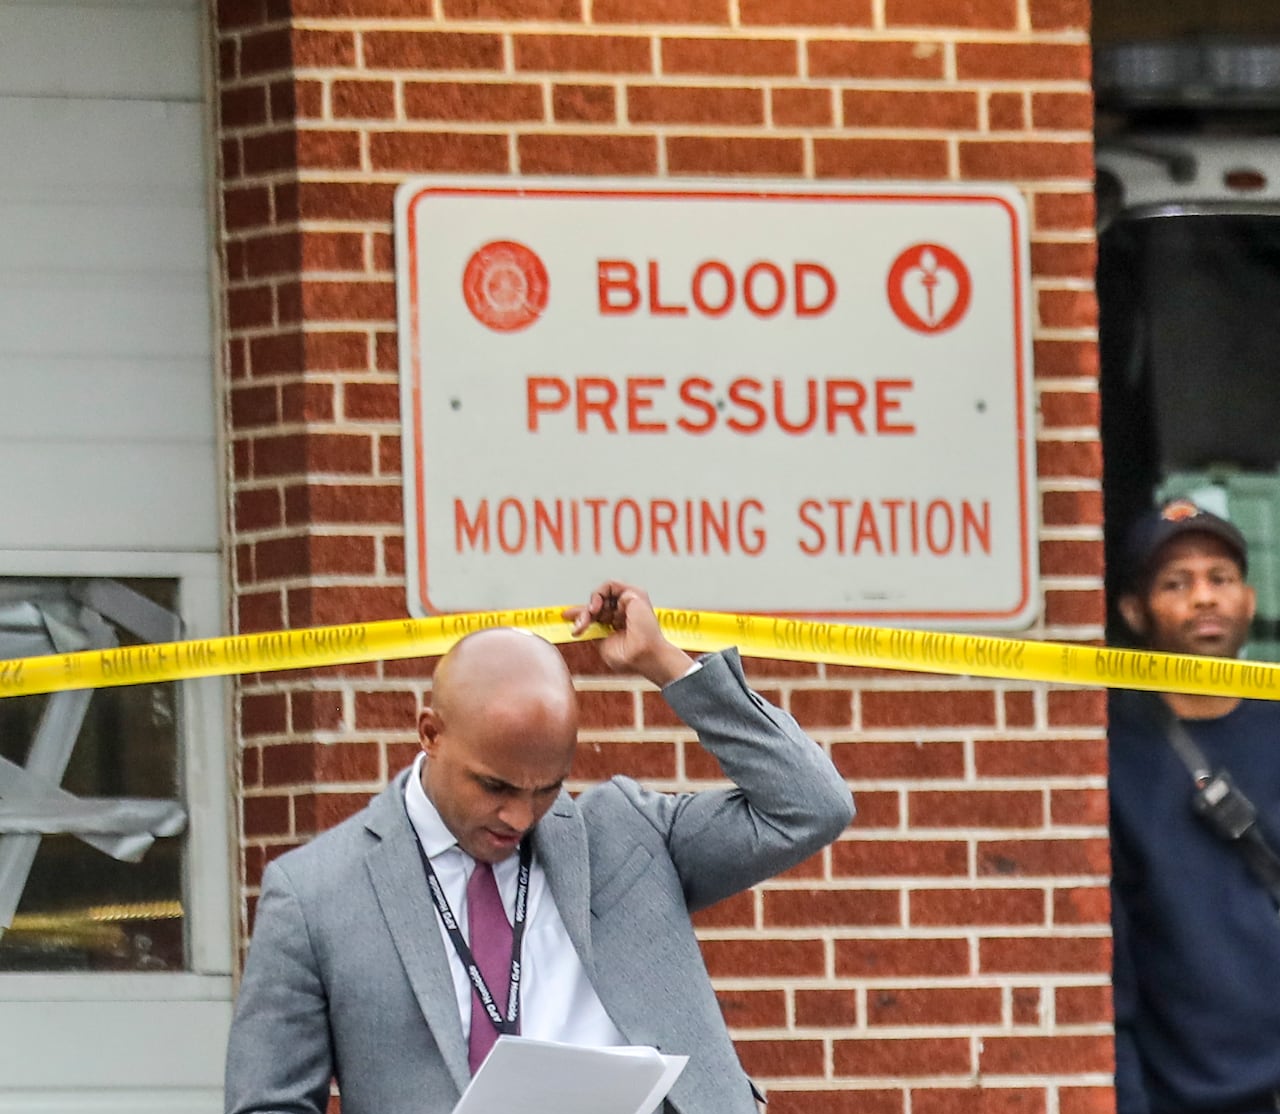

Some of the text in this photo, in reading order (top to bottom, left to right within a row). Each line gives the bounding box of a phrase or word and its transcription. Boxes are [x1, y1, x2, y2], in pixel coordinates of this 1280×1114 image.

[597, 260, 836, 318] BLOOD
[526, 375, 916, 435] PRESSURE
[454, 497, 990, 555] MONITORING STATION
